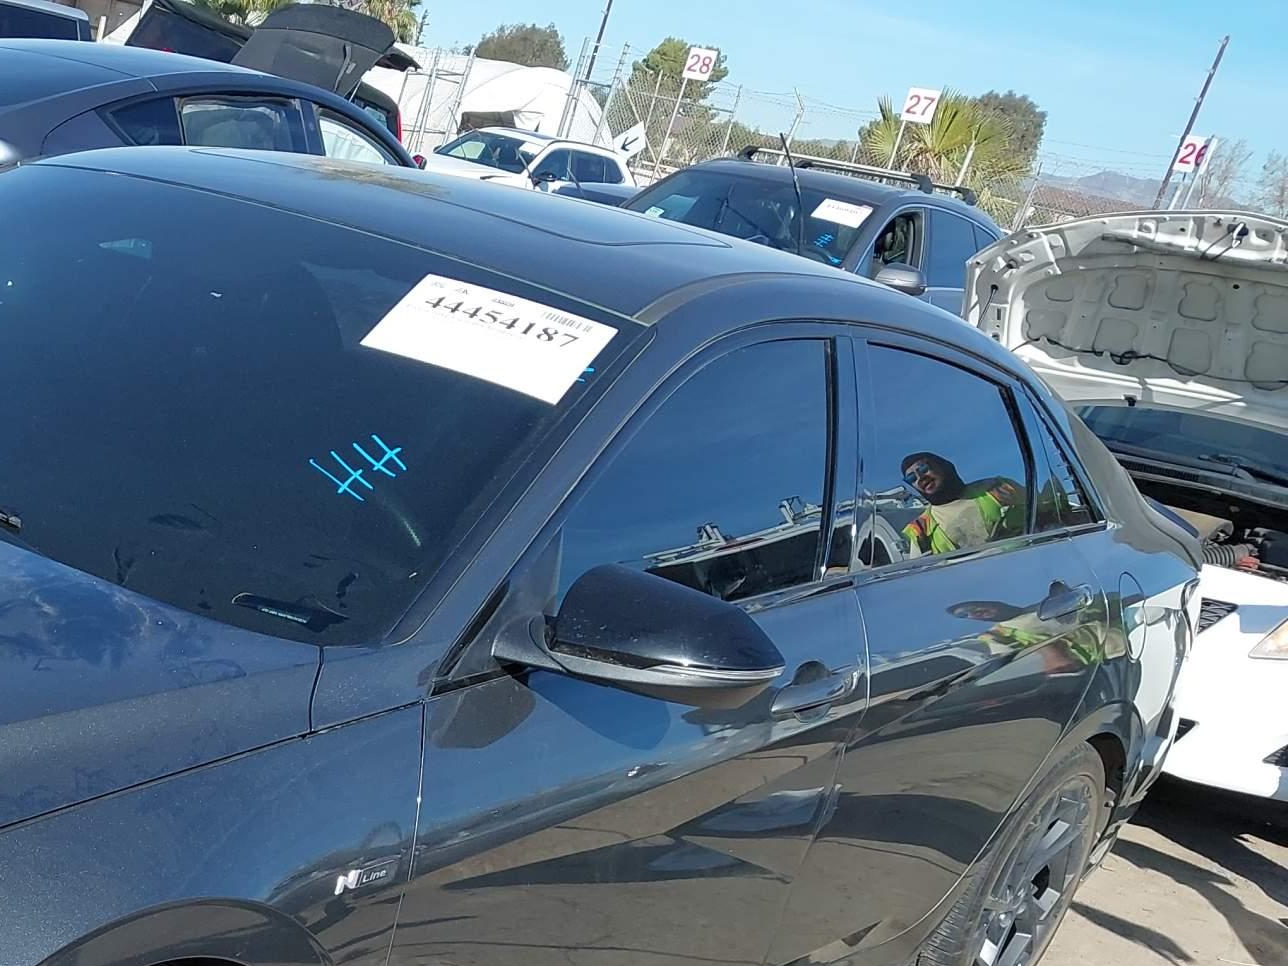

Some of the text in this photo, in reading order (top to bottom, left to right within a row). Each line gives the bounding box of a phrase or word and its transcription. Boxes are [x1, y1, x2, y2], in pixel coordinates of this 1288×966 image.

[687, 54, 712, 74] 28
[905, 94, 936, 116] 27
[425, 296, 580, 347] 44454187
[334, 869, 362, 896] N
